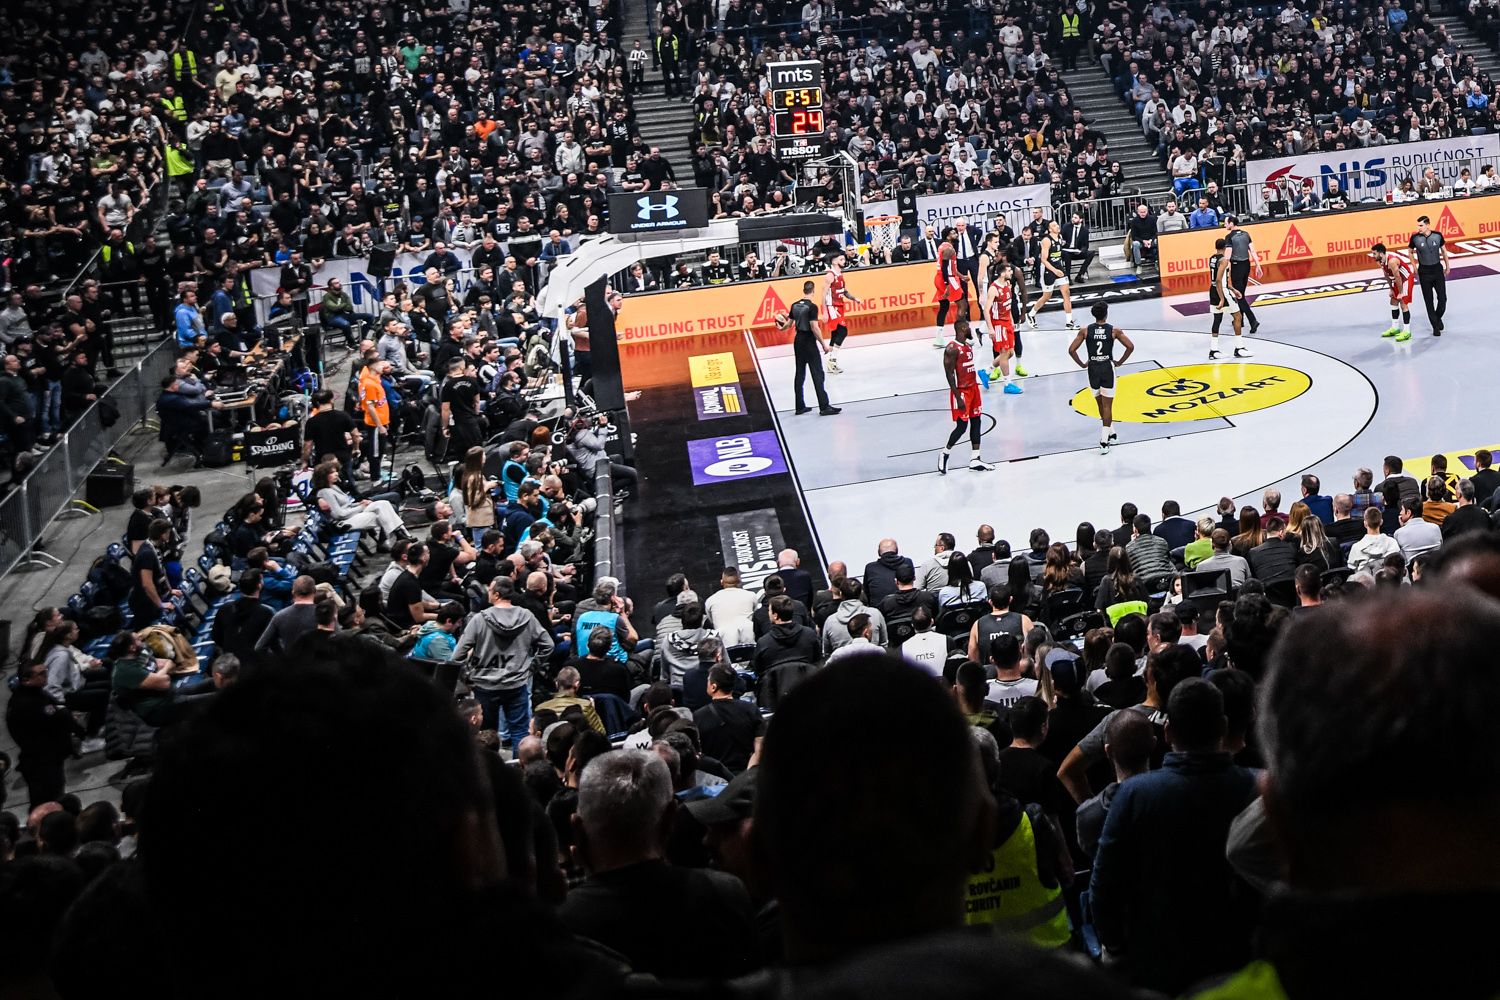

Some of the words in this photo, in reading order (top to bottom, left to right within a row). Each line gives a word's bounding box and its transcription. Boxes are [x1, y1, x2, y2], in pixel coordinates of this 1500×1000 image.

[778, 68, 813, 83] mts
[785, 89, 820, 106] 2:51
[793, 112, 823, 134] 24
[780, 145, 821, 156] TISSOT
[1392, 147, 1484, 167] BUDUĆNOST
[1320, 157, 1386, 193] NIS
[927, 198, 1033, 221] BUDUĆNOST
[656, 219, 687, 227] ARMOUR
[1283, 237, 1308, 257] Sika
[1327, 235, 1384, 253] BUILDING
[880, 293, 925, 308] TRUST
[624, 320, 694, 340] BUILDING
[697, 314, 745, 331] TRUST
[1096, 341, 1103, 356] 2
[1142, 376, 1287, 418] MOZZART
[250, 440, 294, 455] SPALDING
[715, 437, 753, 460] NLB
[916, 651, 935, 661] mts
[969, 876, 1021, 896] ROVČANIN
